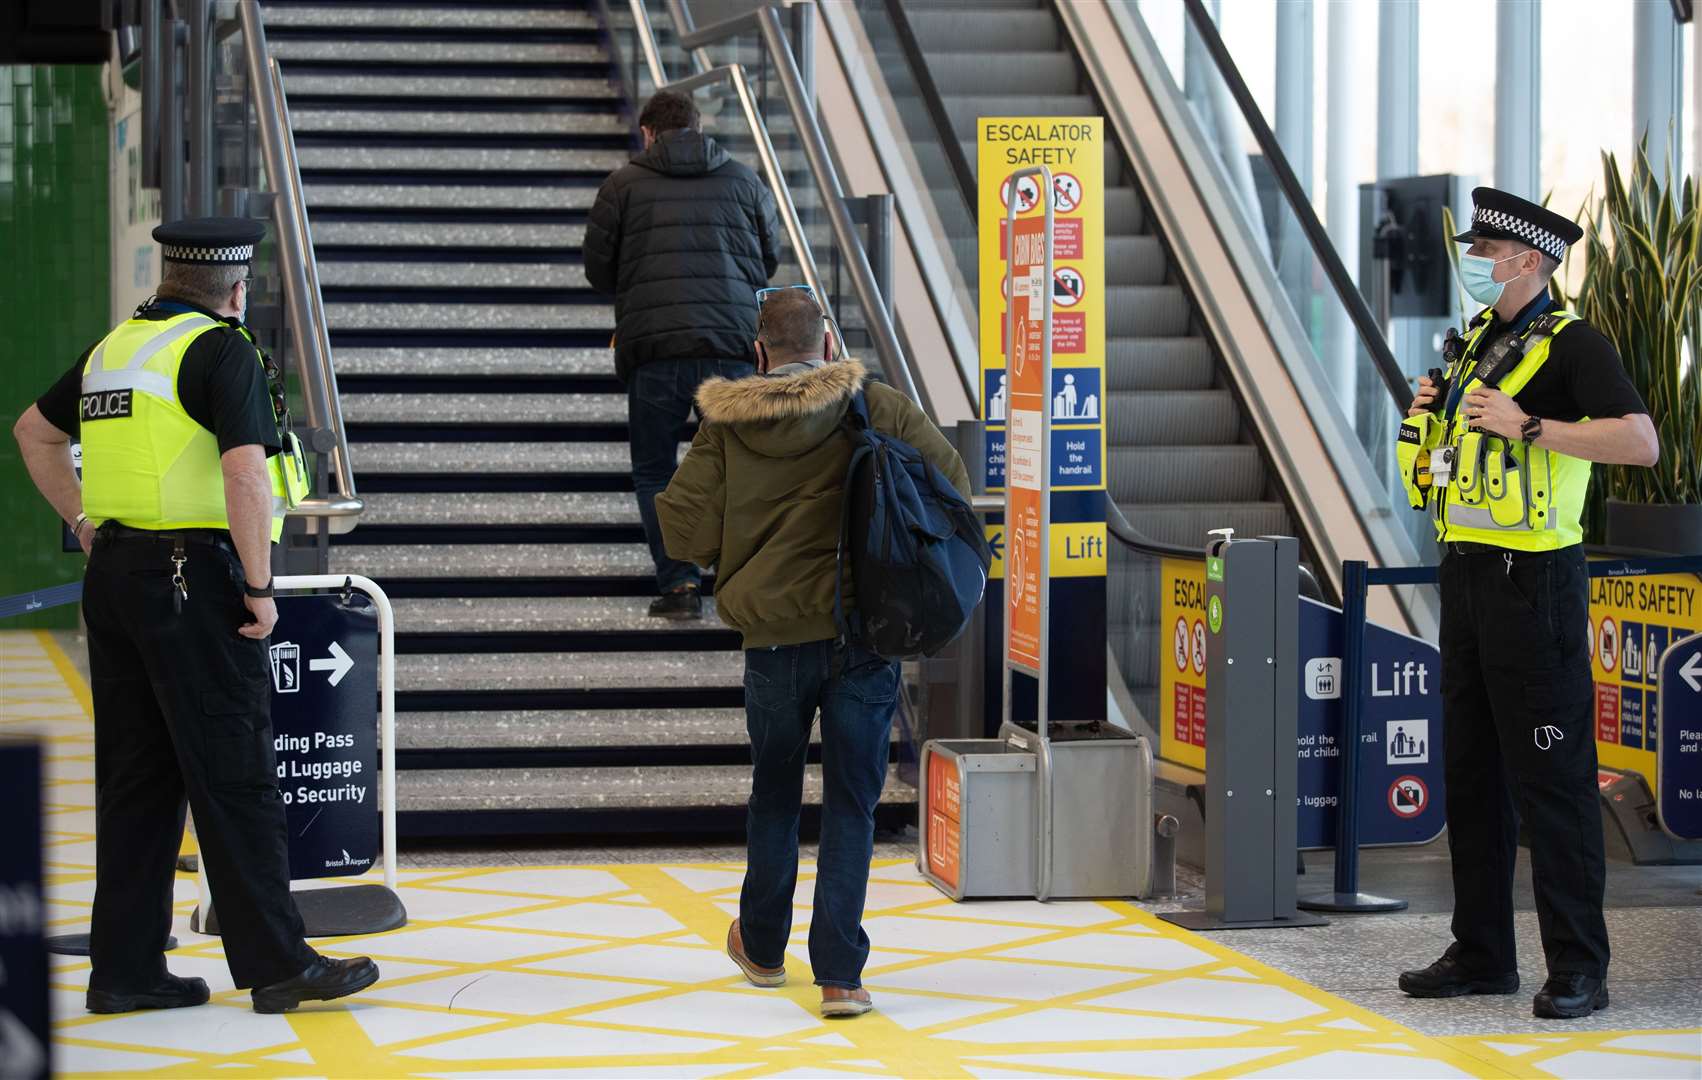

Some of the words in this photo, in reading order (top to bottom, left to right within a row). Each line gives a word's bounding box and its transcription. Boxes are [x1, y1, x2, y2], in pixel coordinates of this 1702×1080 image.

[986, 124, 1092, 141] ESCALATOR
[1006, 147, 1077, 164] SAFETY
[1015, 234, 1030, 266] CABIN
[1030, 232, 1045, 265] BAGS
[83, 392, 129, 418] POLICE
[1066, 441, 1086, 451] Hold
[1069, 453, 1083, 463] the
[988, 467, 998, 476] at
[1059, 465, 1093, 475] handrail
[1066, 536, 1103, 559] Lift
[1174, 578, 1206, 610] ESCAL
[1590, 577, 1634, 609] LATOR
[1638, 582, 1695, 617] SAFETY
[1371, 661, 1428, 697] Lift
[274, 733, 310, 754] ding
[315, 732, 354, 749] Pass
[1318, 734, 1335, 745] the
[1361, 732, 1378, 743] rail
[1298, 747, 1311, 758] nd
[1680, 742, 1698, 753] and
[276, 761, 287, 778] d
[291, 760, 362, 779] Luggage
[297, 784, 367, 804] Security
[1304, 795, 1338, 807] luggag
[1679, 788, 1693, 800] No
[325, 859, 344, 868] Bristol
[349, 857, 370, 867] Airport
